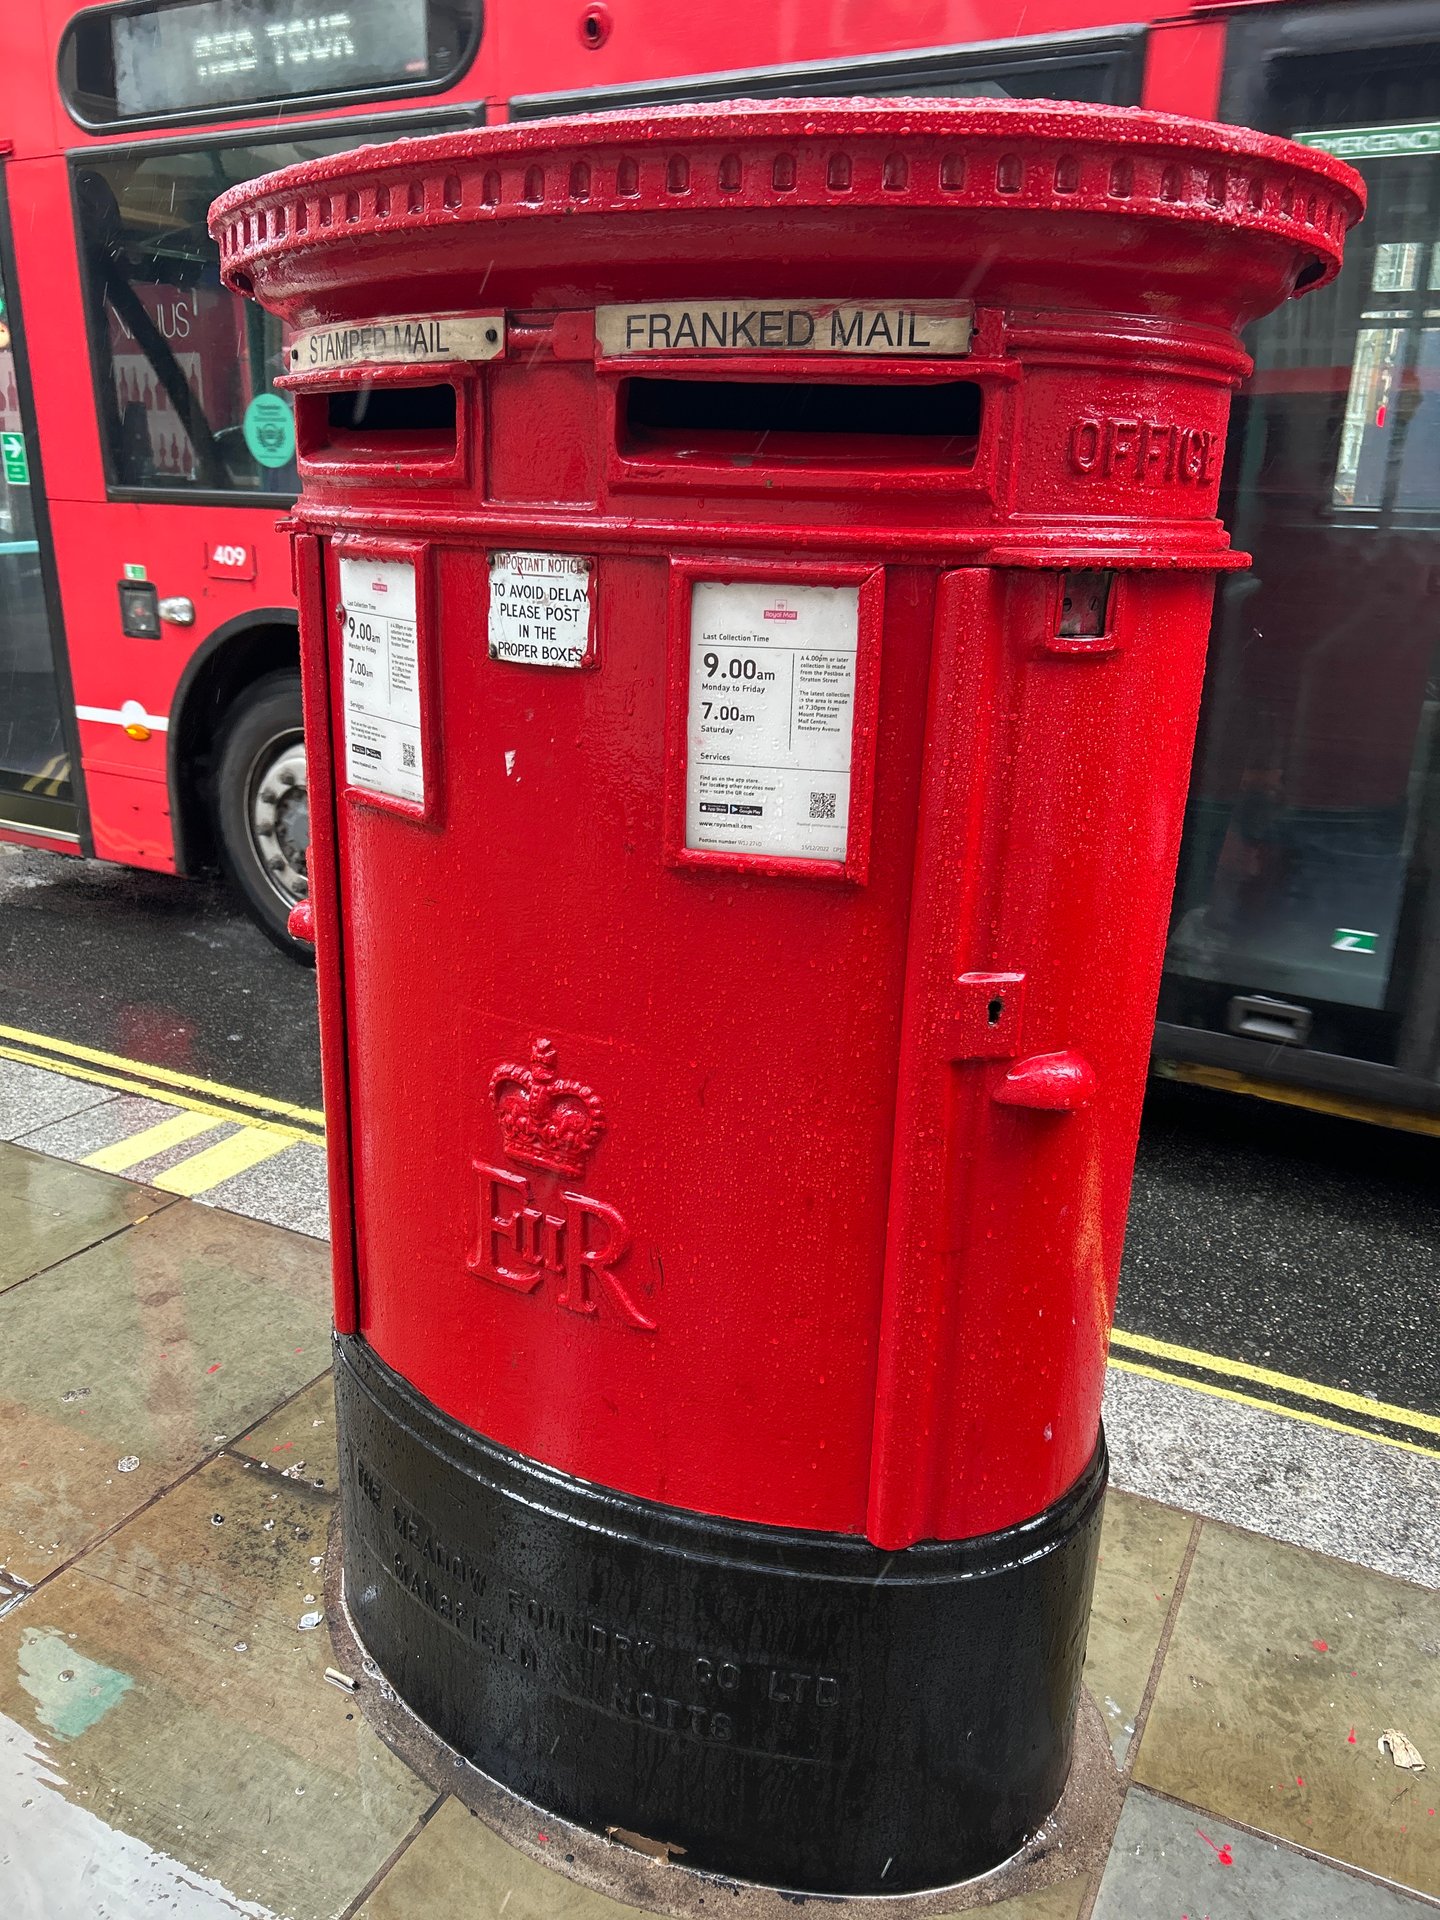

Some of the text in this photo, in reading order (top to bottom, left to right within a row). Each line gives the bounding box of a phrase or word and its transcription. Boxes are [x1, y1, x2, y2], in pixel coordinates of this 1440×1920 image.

[626, 310, 931, 350] FRANKED MAIL
[310, 322, 450, 364] STAMPED MAIL
[1069, 415, 1218, 486] OFFICE
[213, 545, 247, 567] 409
[497, 555, 545, 572] IMPORTANT
[493, 582, 588, 602] TO AVOID DELAY
[500, 603, 580, 622] PLEASE POST
[765, 611, 782, 619] Royal
[348, 616, 381, 644] 9.00am
[519, 624, 557, 640] IN THE
[702, 633, 770, 643] Last Collection Time
[498, 641, 583, 662] PROPER BOXES
[349, 657, 374, 678] 7.00am
[703, 652, 776, 681] 9.00am
[701, 683, 766, 695] Monday to Friday
[701, 702, 756, 722] 7.00am
[700, 725, 734, 736] Saturday
[700, 752, 731, 761] Services
[698, 821, 753, 830] www.royalmail.com
[508, 1588, 656, 1668] FOUNDRY
[691, 1655, 741, 1691] CO
[768, 1668, 840, 1707] LTD
[614, 1682, 733, 1741] NOTTS
